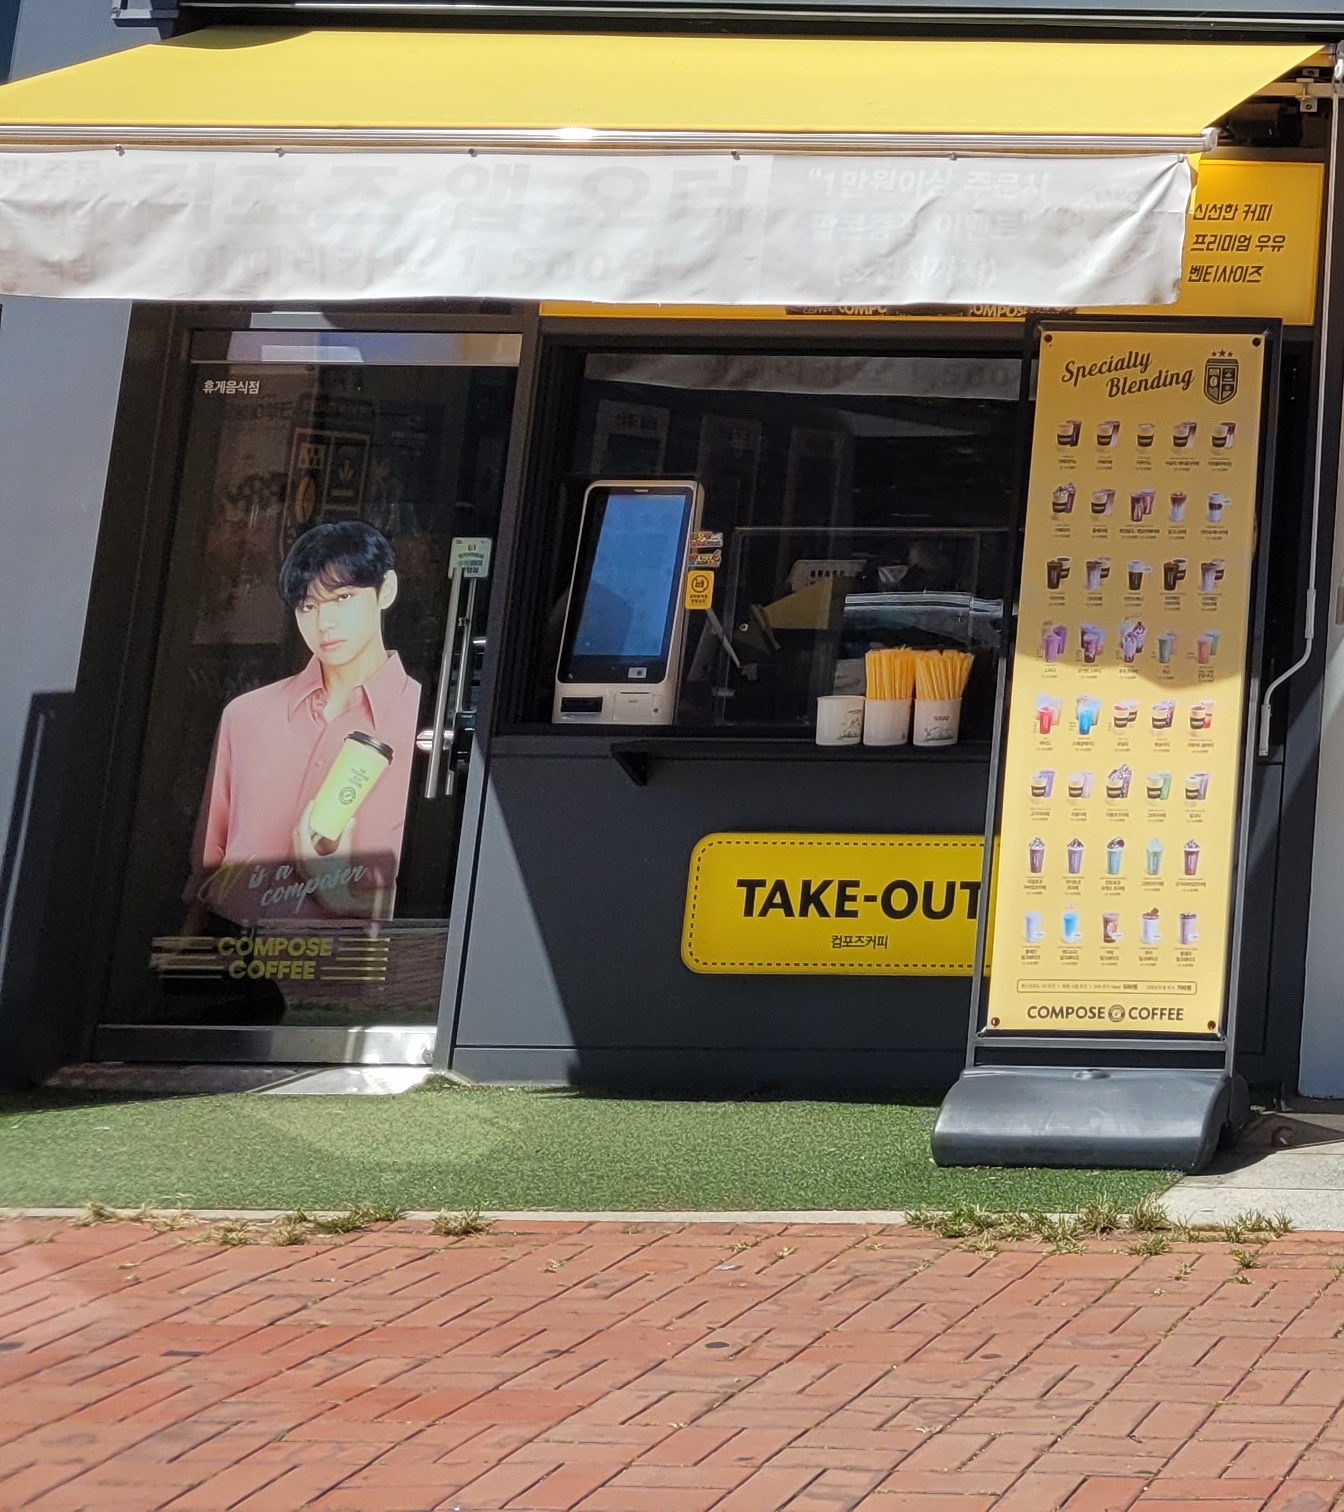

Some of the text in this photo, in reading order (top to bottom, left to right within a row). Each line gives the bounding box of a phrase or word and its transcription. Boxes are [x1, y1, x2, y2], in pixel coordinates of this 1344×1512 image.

[1193, 203, 1273, 221] 신선한 커피
[1190, 234, 1286, 252] 프리미엄 우유
[1188, 265, 1264, 283] 벤티사이즈
[202, 380, 259, 394] 휴게음식점
[1106, 370, 1195, 398] Blending
[261, 864, 367, 912] composer
[736, 878, 982, 920] TAKE-OUT
[217, 937, 333, 957] COMPOSE
[831, 935, 888, 949] 컴포즈커피
[228, 960, 316, 980] COFFEE
[1027, 1005, 1184, 1021] COMPOSE COFFEE
